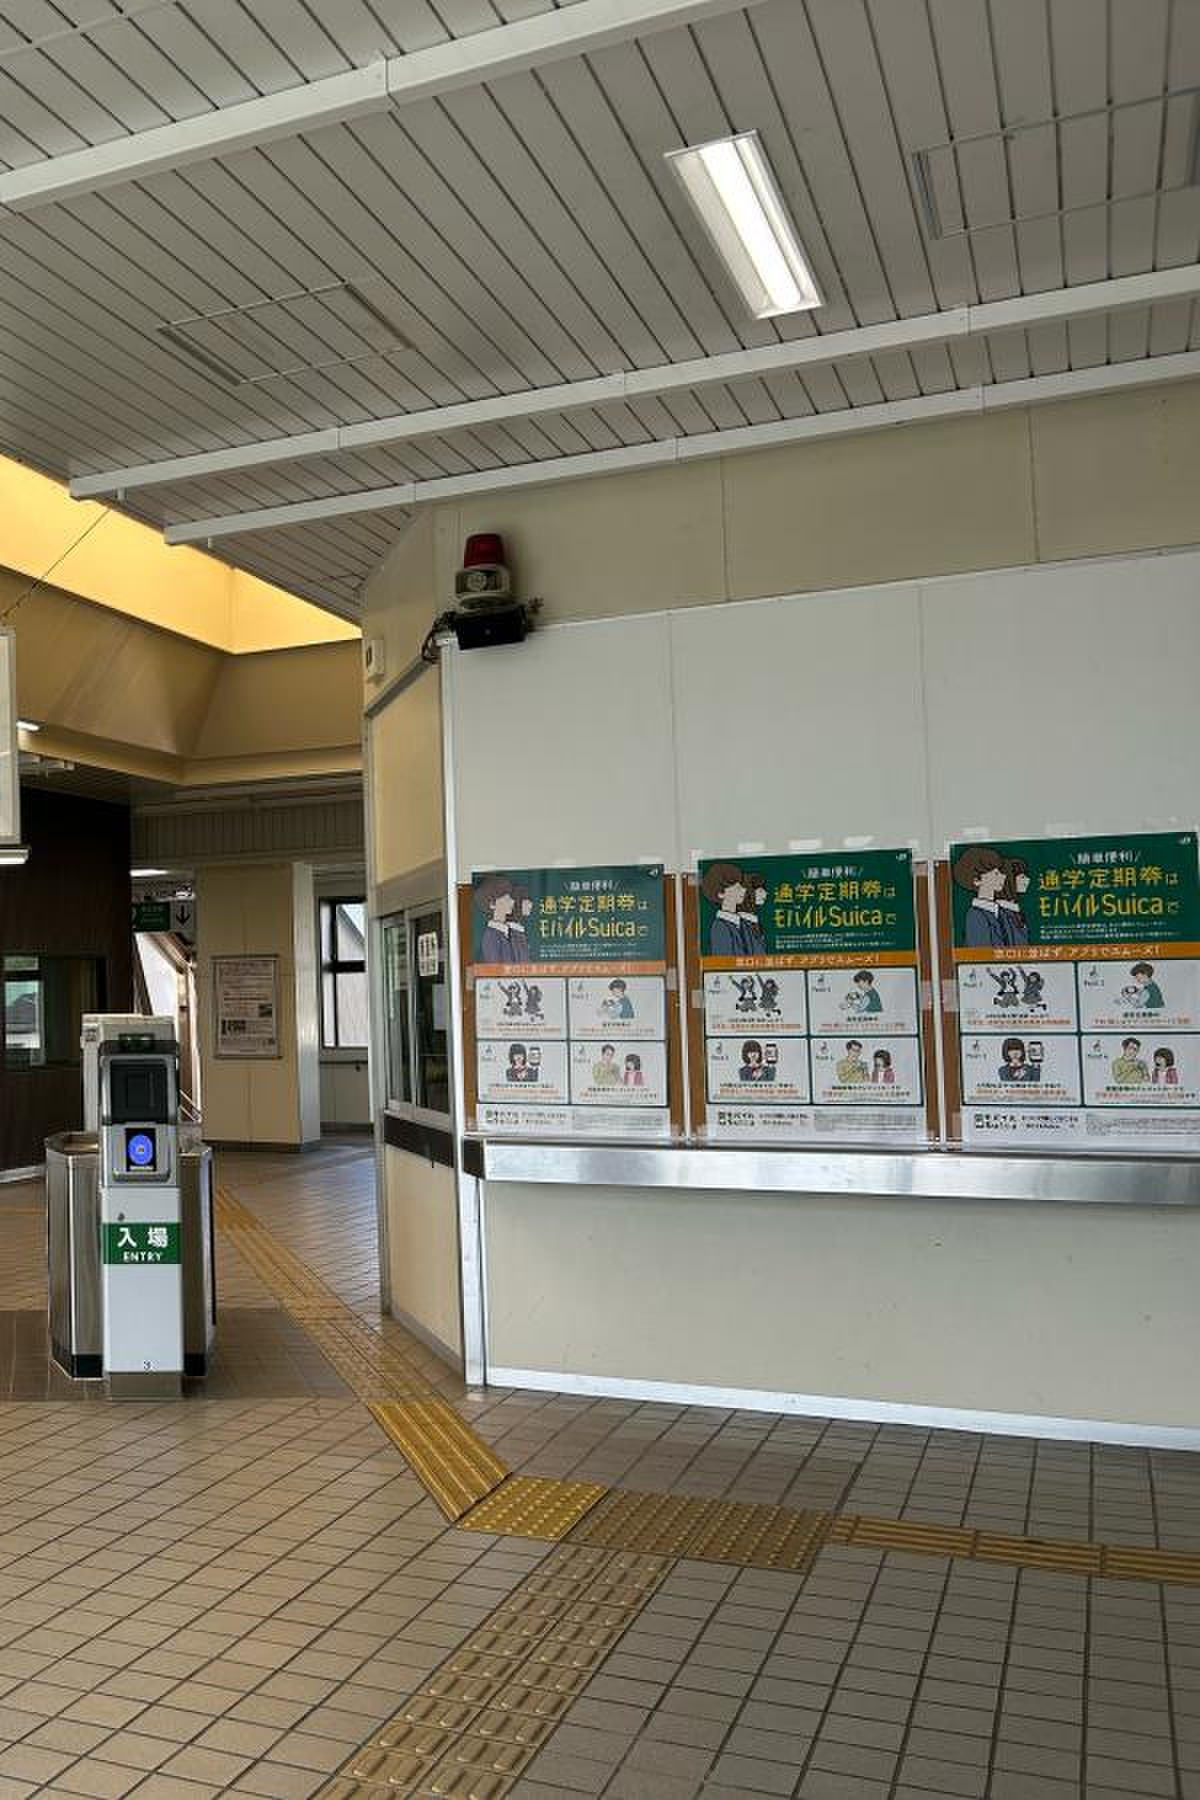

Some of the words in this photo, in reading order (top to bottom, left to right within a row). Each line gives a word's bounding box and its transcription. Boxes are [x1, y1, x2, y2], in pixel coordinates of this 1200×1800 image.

[1039, 865, 1179, 890] 通学定期券は
[774, 880, 896, 903] 通学定期券は
[540, 894, 648, 914] 通学定期券は
[1039, 892, 1181, 918] モバイルSuicaで
[538, 916, 649, 938] モバイルSuicaで
[774, 904, 897, 928] モバイルSuicaで
[117, 1226, 168, 1248] 入場
[123, 1251, 163, 1261] ENTRY
